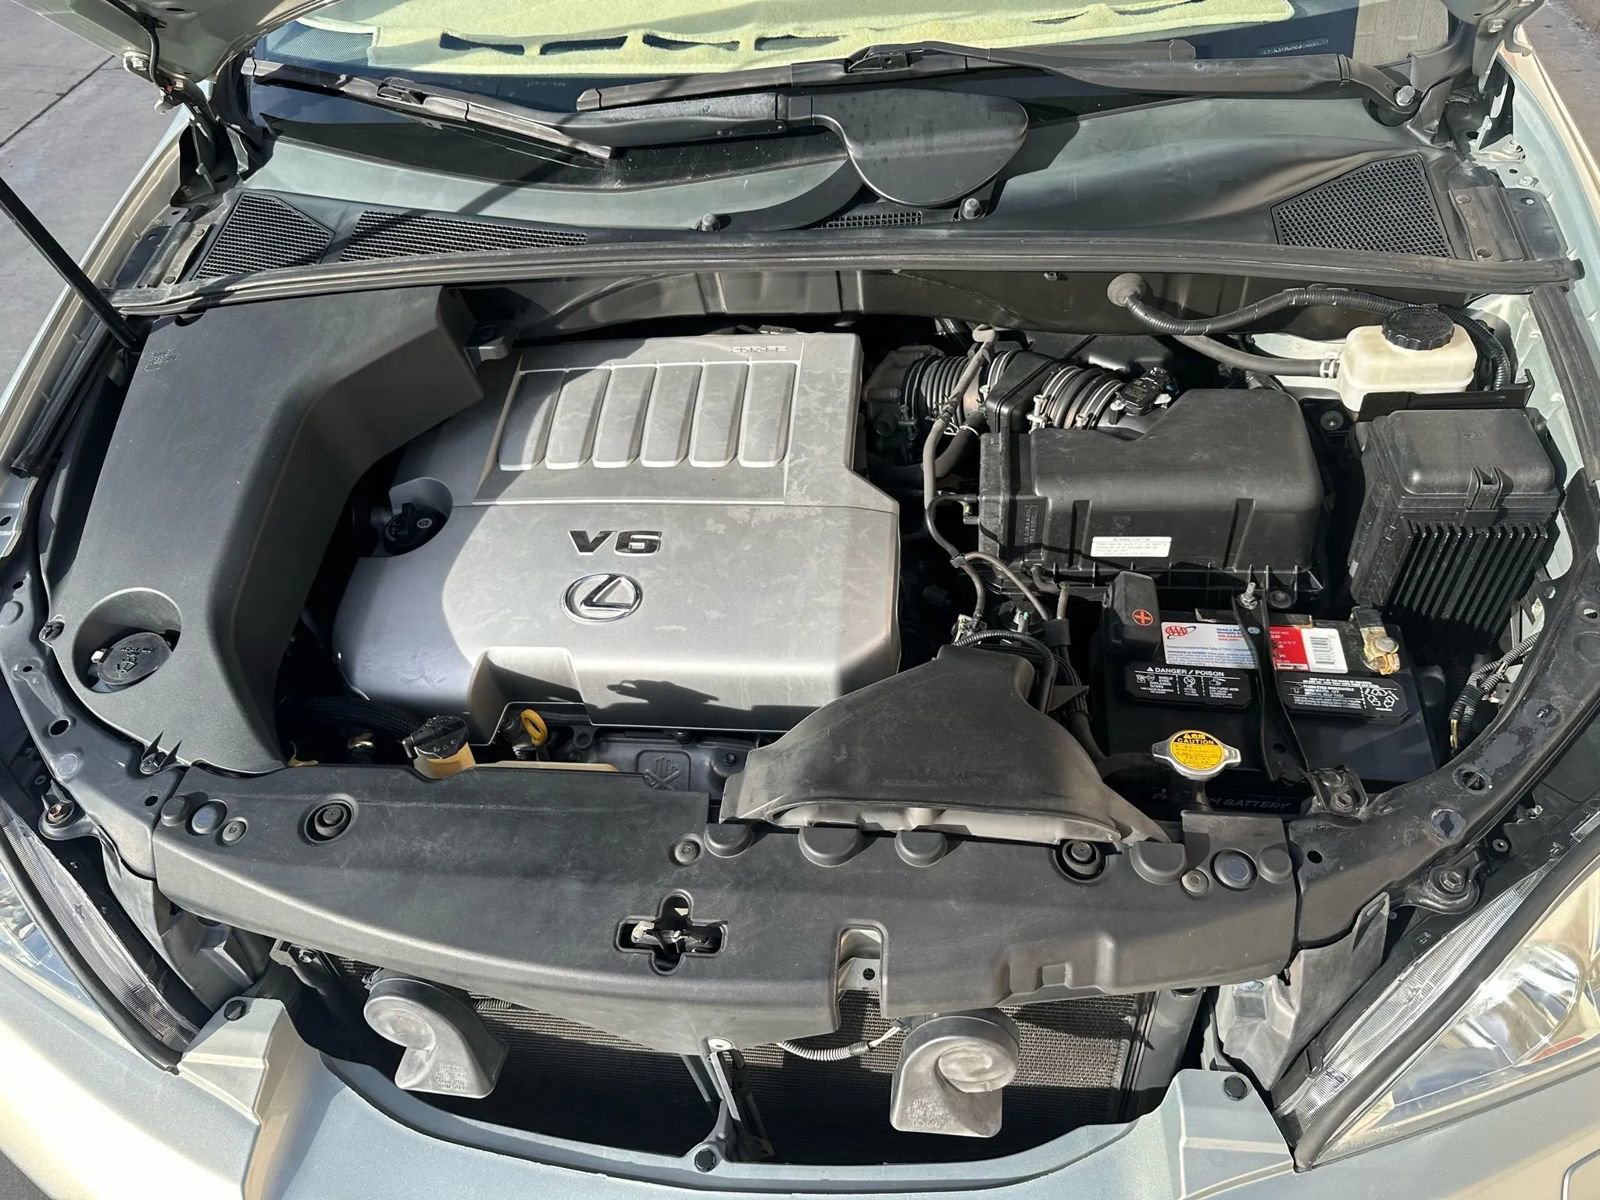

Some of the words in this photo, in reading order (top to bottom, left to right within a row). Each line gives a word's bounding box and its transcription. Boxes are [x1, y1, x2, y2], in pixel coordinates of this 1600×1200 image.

[568, 530, 662, 556] V6
[1166, 626, 1187, 636] AAA
[1154, 667, 1187, 675] DANGER
[1195, 669, 1225, 677] POISON
[1223, 799, 1292, 809] BATTERY
